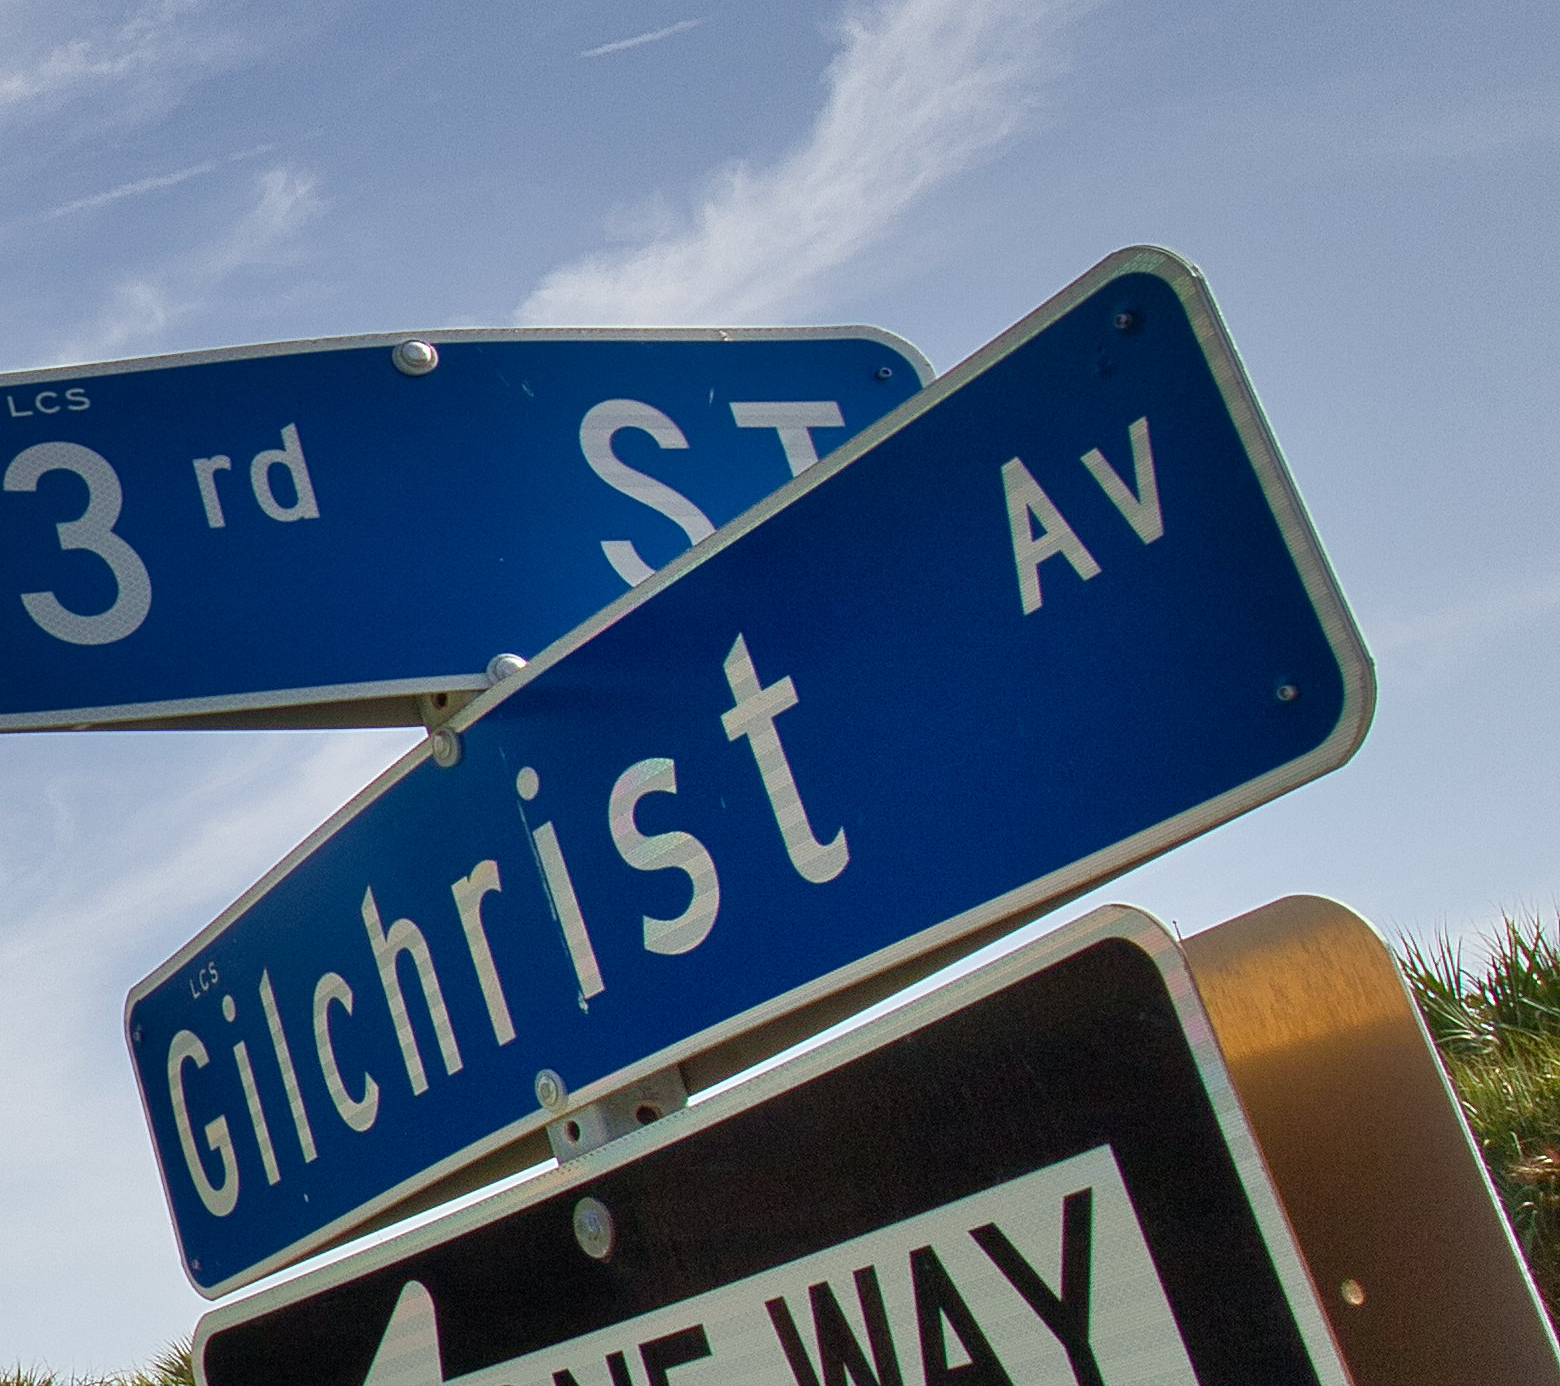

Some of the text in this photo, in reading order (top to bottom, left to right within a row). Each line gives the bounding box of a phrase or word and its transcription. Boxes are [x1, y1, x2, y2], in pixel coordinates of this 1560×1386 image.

[7, 388, 91, 417] LCS
[2, 441, 152, 645] 3
[192, 422, 320, 528] rd
[167, 632, 850, 1216] Gilchrist
[189, 961, 218, 999] LCS
